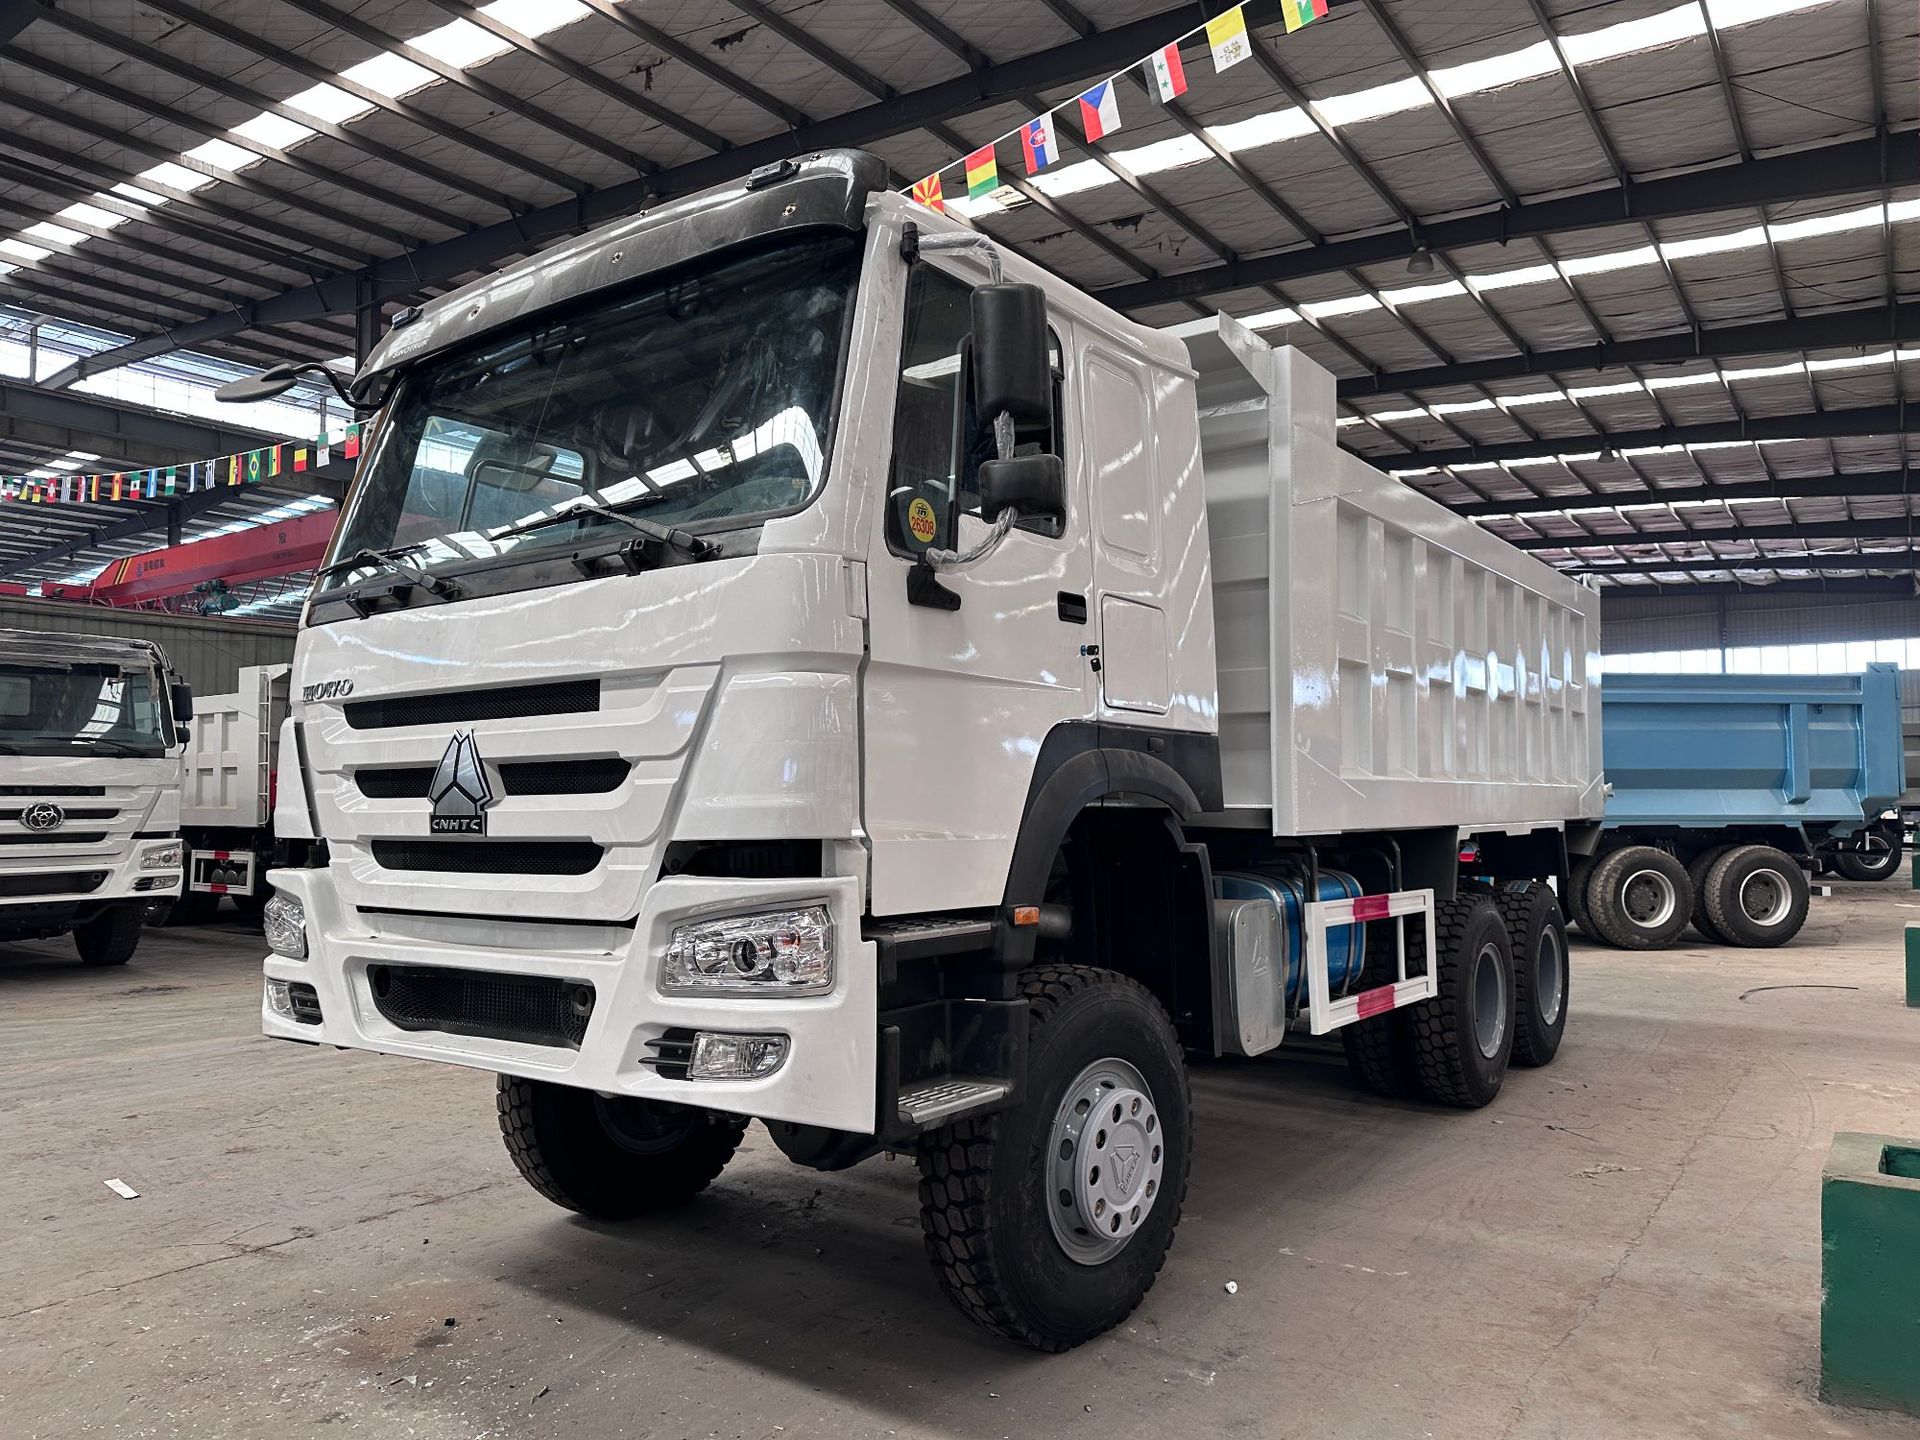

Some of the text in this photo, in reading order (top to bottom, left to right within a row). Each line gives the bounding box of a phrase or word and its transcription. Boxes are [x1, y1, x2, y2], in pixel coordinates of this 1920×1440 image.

[911, 516, 934, 536] 26308
[301, 679, 354, 702] HOWO
[431, 819, 481, 831] CNHTC
